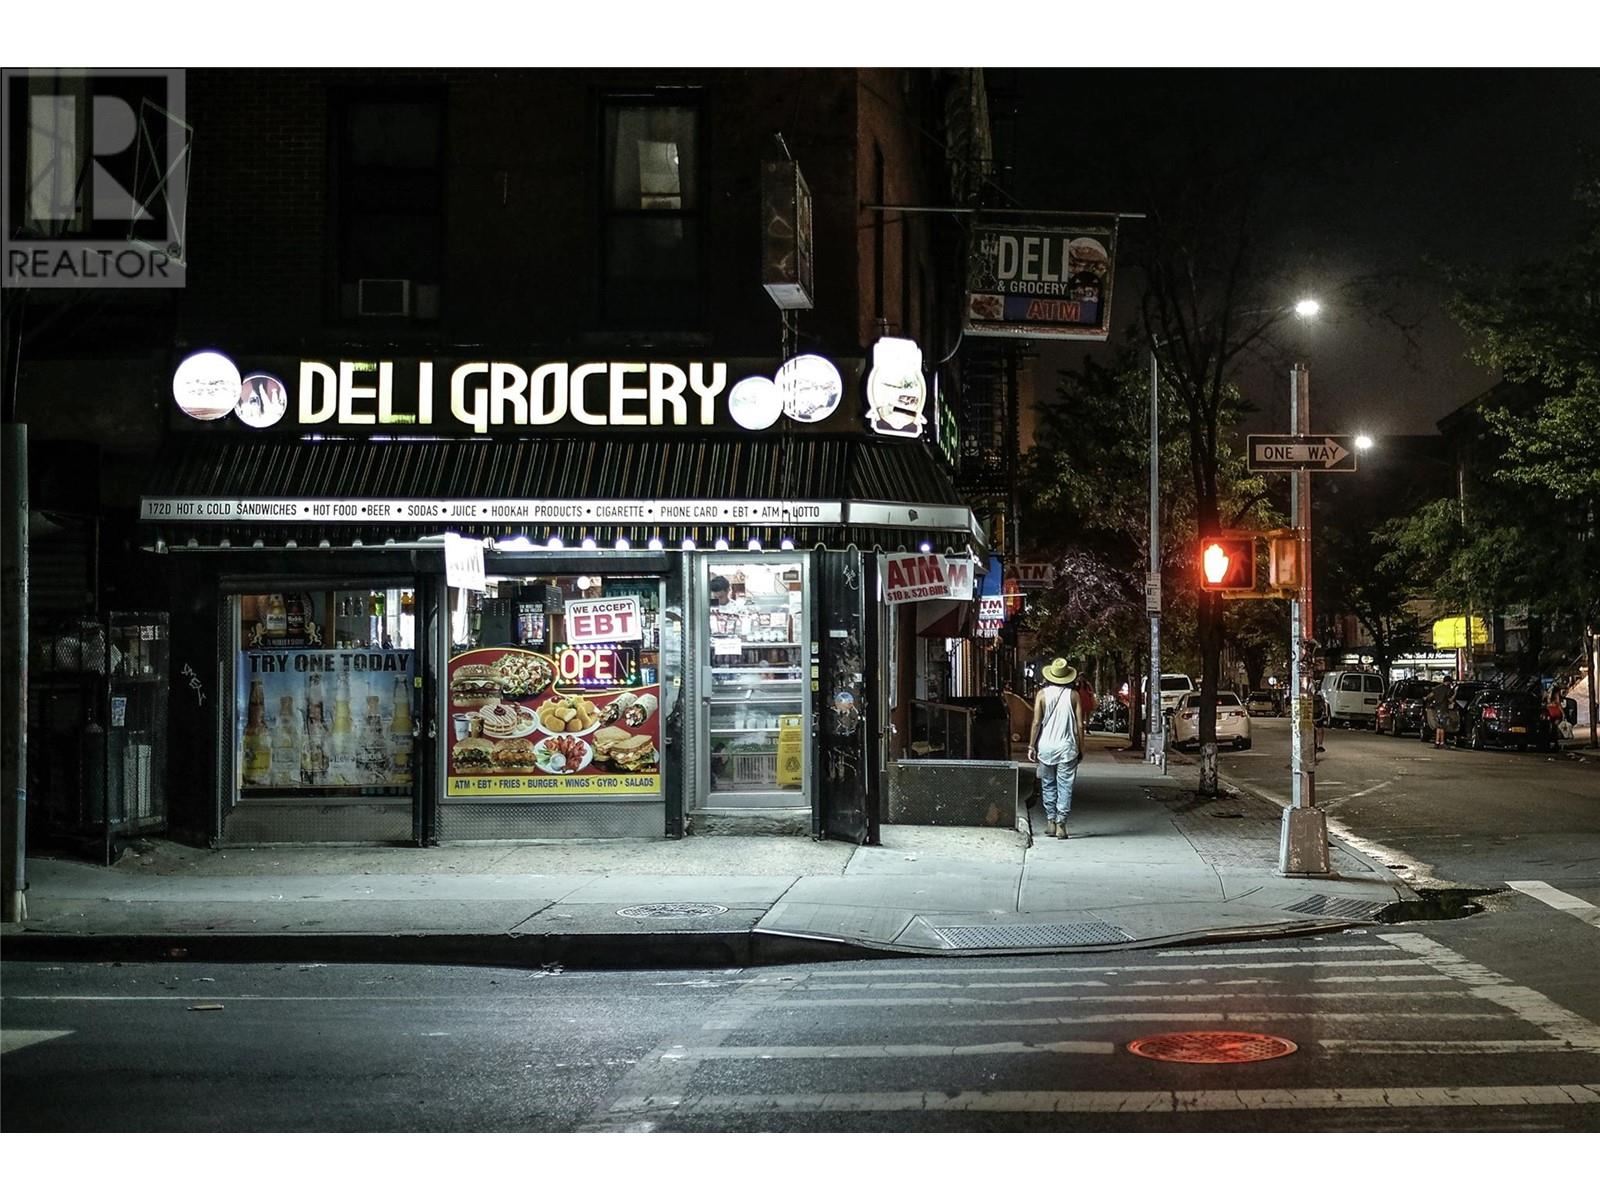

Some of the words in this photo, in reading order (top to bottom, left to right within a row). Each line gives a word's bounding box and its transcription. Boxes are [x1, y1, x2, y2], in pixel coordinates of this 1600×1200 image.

[998, 235, 1071, 282] DELI
[997, 280, 1006, 292] &
[1010, 281, 1068, 296] GROCERY
[1026, 300, 1080, 321] ATM
[299, 361, 433, 424] DELI
[451, 361, 727, 433] GROCERY
[1264, 446, 1294, 460] ONE
[1308, 446, 1339, 460] WAY
[176, 503, 195, 515] HOT
[197, 504, 203, 515] &
[207, 503, 231, 515] COLD
[236, 503, 297, 516] SANDWICHES
[313, 504, 331, 516] HOT
[333, 504, 357, 516] FOOD
[367, 504, 390, 516] BEER
[408, 505, 438, 516] SODAS
[451, 505, 476, 517] JUICE
[492, 505, 528, 517] HOOKAH
[535, 505, 582, 517] PRODUCTS
[596, 505, 644, 517] CIGARETTE
[661, 506, 692, 517] PHONE
[694, 506, 718, 517] CARD
[733, 506, 748, 518] EBT
[762, 506, 779, 518] ATM
[793, 506, 820, 518] LOTTO
[887, 555, 945, 589] ATM
[887, 591, 903, 601] $10
[912, 588, 929, 598] $20
[573, 606, 589, 614] WE
[591, 602, 633, 612] ACCEPT
[573, 612, 633, 637] EBT
[248, 654, 289, 673] TRY
[294, 653, 335, 673] ONE
[340, 653, 410, 673] TODAY
[560, 650, 630, 679] OPEN
[454, 780, 470, 790] ATM
[477, 780, 492, 789] EBT
[499, 780, 520, 789] FRIES
[527, 779, 558, 789] BURGER
[565, 779, 590, 788] WINGS
[597, 779, 617, 788] GYRO
[625, 778, 654, 788] SALADS
